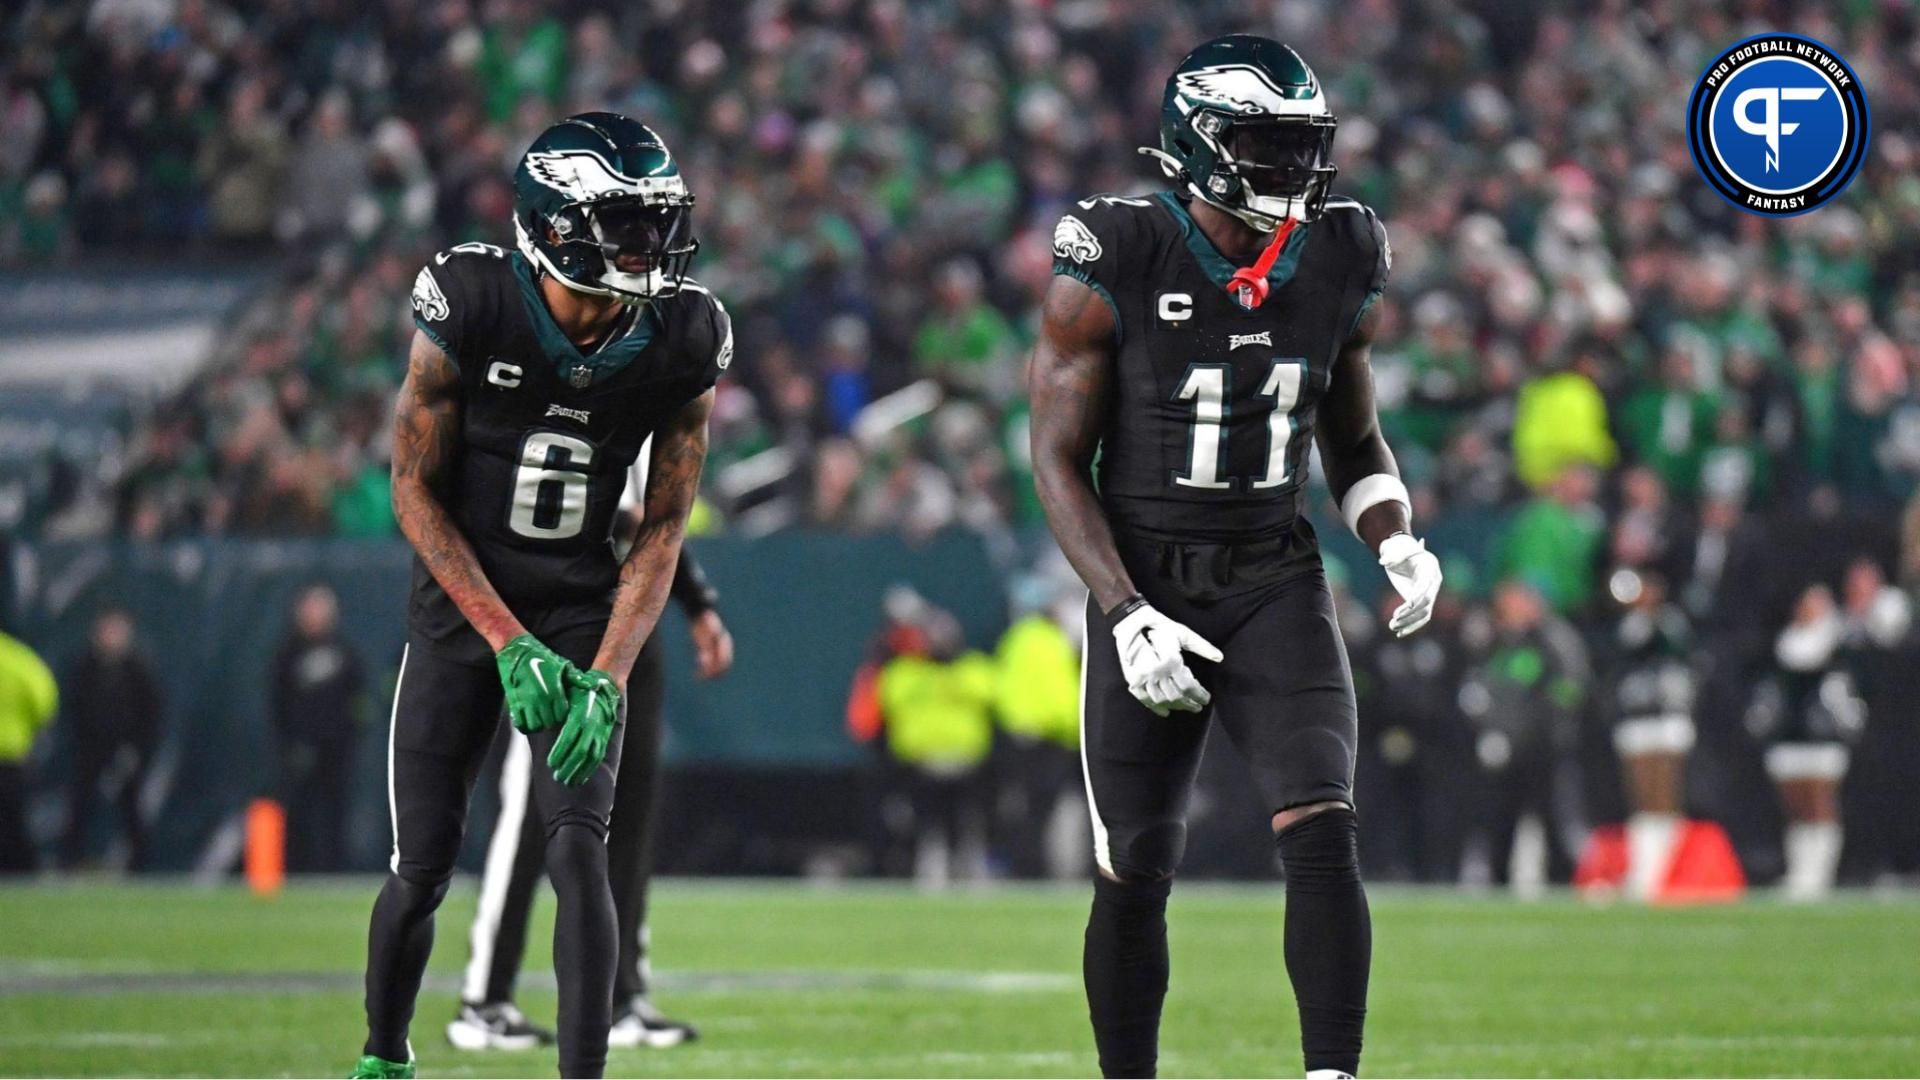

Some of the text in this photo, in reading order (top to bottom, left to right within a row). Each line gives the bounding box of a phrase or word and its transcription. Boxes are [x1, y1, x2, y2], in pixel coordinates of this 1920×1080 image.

[1158, 293, 1193, 321] C
[487, 361, 523, 388] C
[544, 403, 592, 425] EAGLES
[1176, 363, 1301, 489] 11
[509, 432, 594, 540] 6
